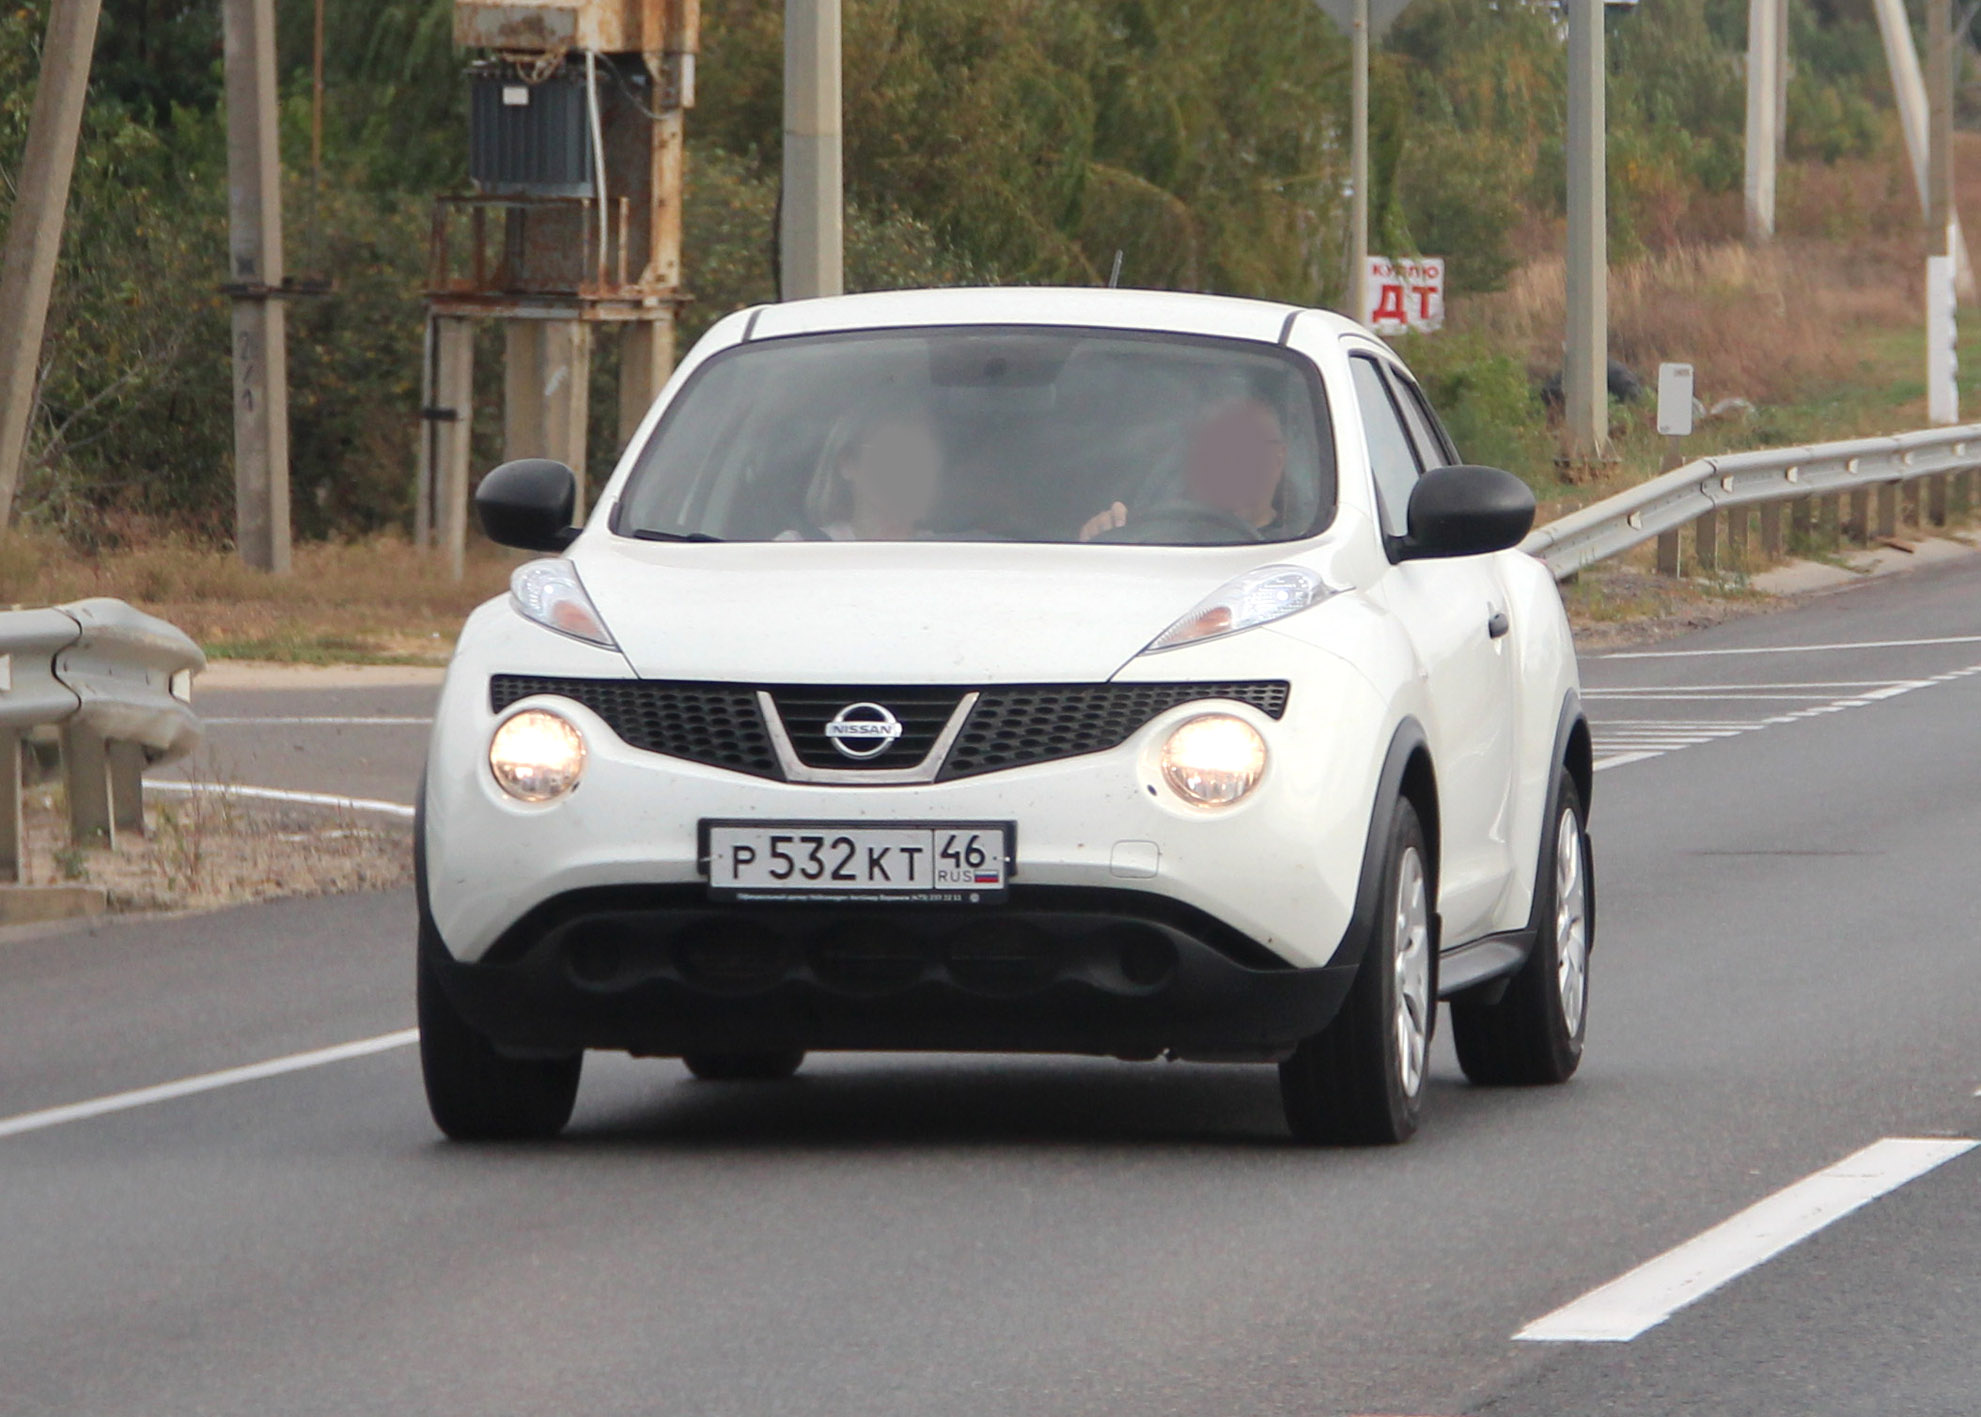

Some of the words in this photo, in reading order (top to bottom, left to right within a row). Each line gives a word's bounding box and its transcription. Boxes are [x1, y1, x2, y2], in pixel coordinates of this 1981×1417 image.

[1372, 285, 1438, 324] ДТ
[833, 722, 891, 734] NISSAN
[940, 834, 986, 868] 46
[938, 870, 973, 883] RUS
